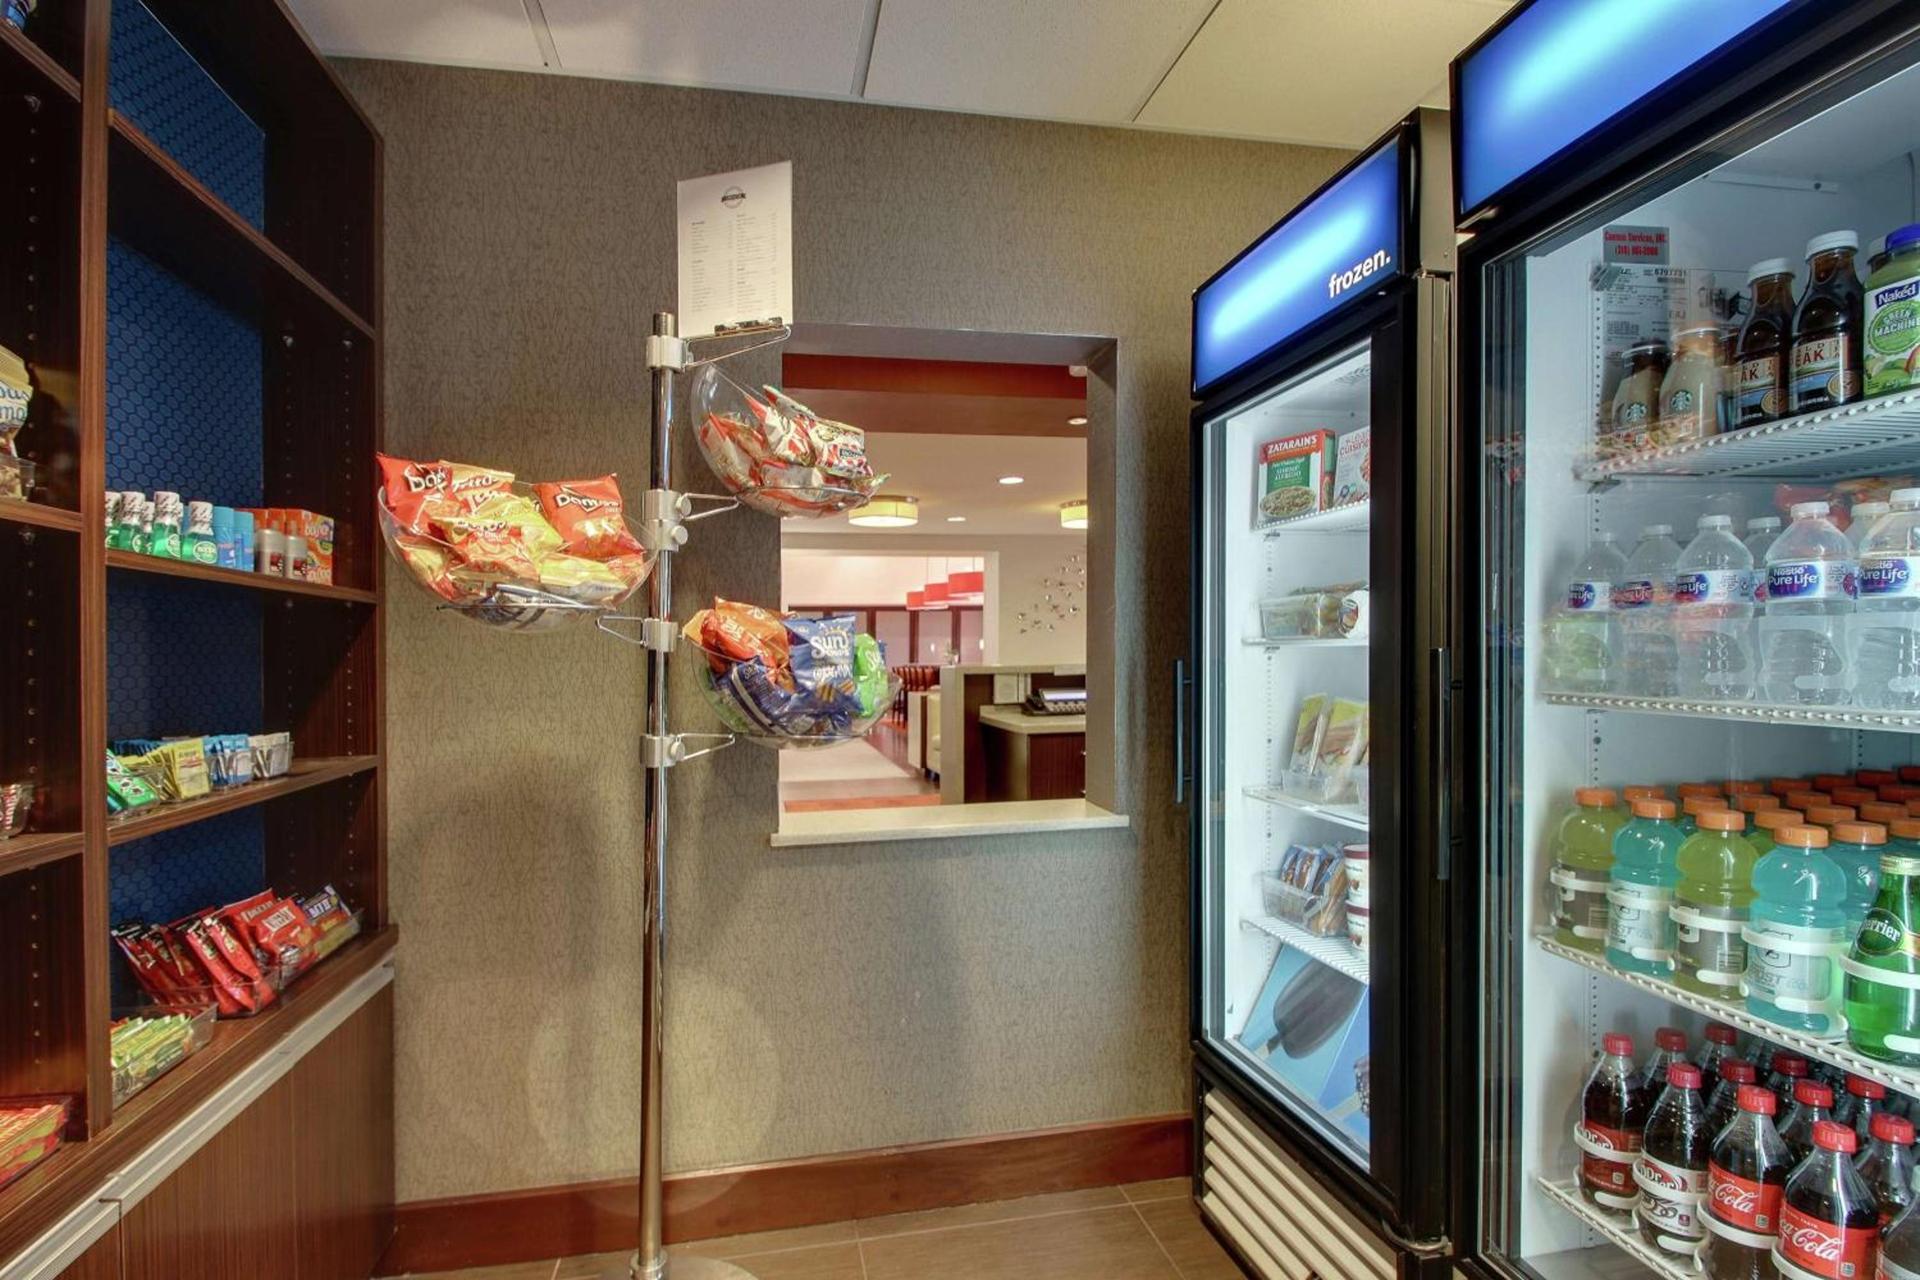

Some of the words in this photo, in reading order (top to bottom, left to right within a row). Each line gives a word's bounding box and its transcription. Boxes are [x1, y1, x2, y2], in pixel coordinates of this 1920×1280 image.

[1328, 249, 1391, 298] frozen.
[1769, 574, 1792, 586] Pure
[1794, 574, 1817, 588] Life
[1881, 568, 1908, 583] Life
[810, 631, 850, 659] Sun
